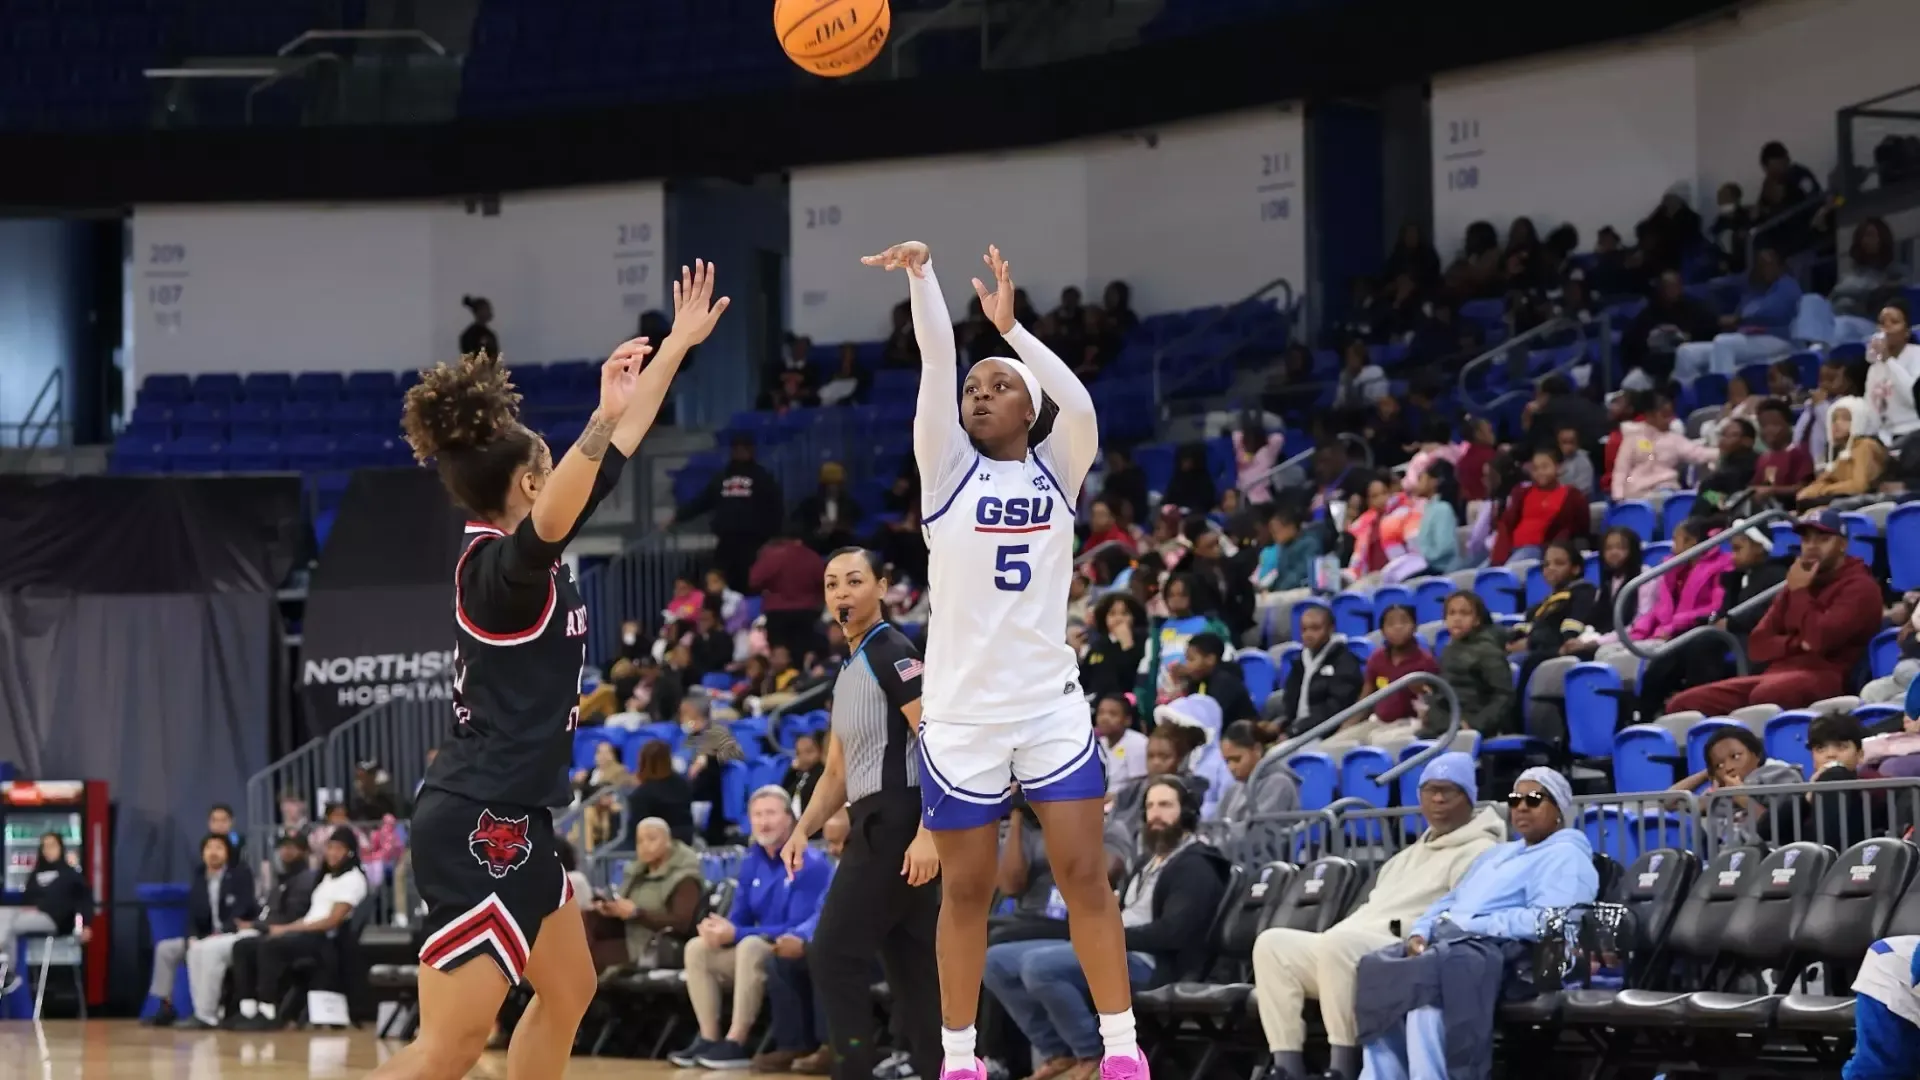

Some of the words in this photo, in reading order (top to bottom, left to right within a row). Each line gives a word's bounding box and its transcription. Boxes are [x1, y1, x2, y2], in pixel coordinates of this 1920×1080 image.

[1448, 121, 1480, 145] 211
[1260, 152, 1291, 176] 211
[805, 205, 841, 229] 210
[617, 264, 650, 286] 107
[148, 285, 184, 306] 107
[976, 495, 1053, 527] GSU
[994, 544, 1032, 592] 5
